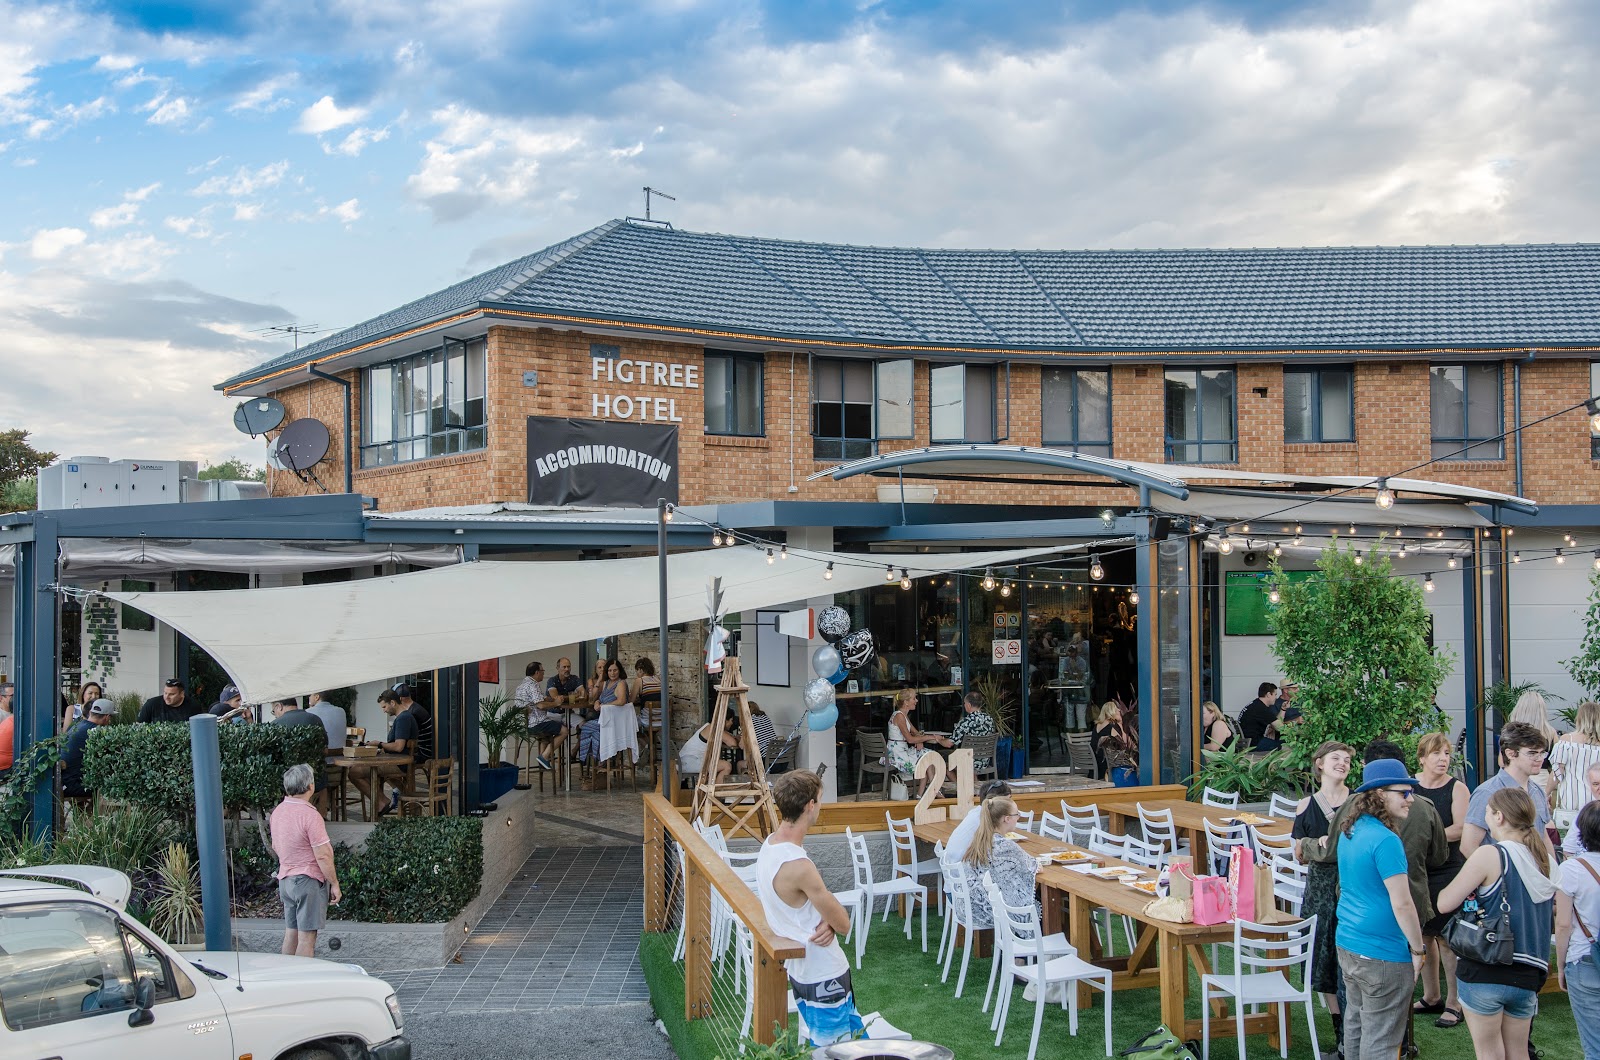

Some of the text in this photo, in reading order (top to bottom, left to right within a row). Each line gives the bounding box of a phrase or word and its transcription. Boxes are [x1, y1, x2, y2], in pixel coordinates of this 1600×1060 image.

[592, 356, 699, 388] FIGTREE
[592, 393, 683, 422] HOTEL
[535, 444, 672, 482] ACCOMMODATION
[914, 748, 976, 825] 21
[187, 1019, 219, 1030] HILUX
